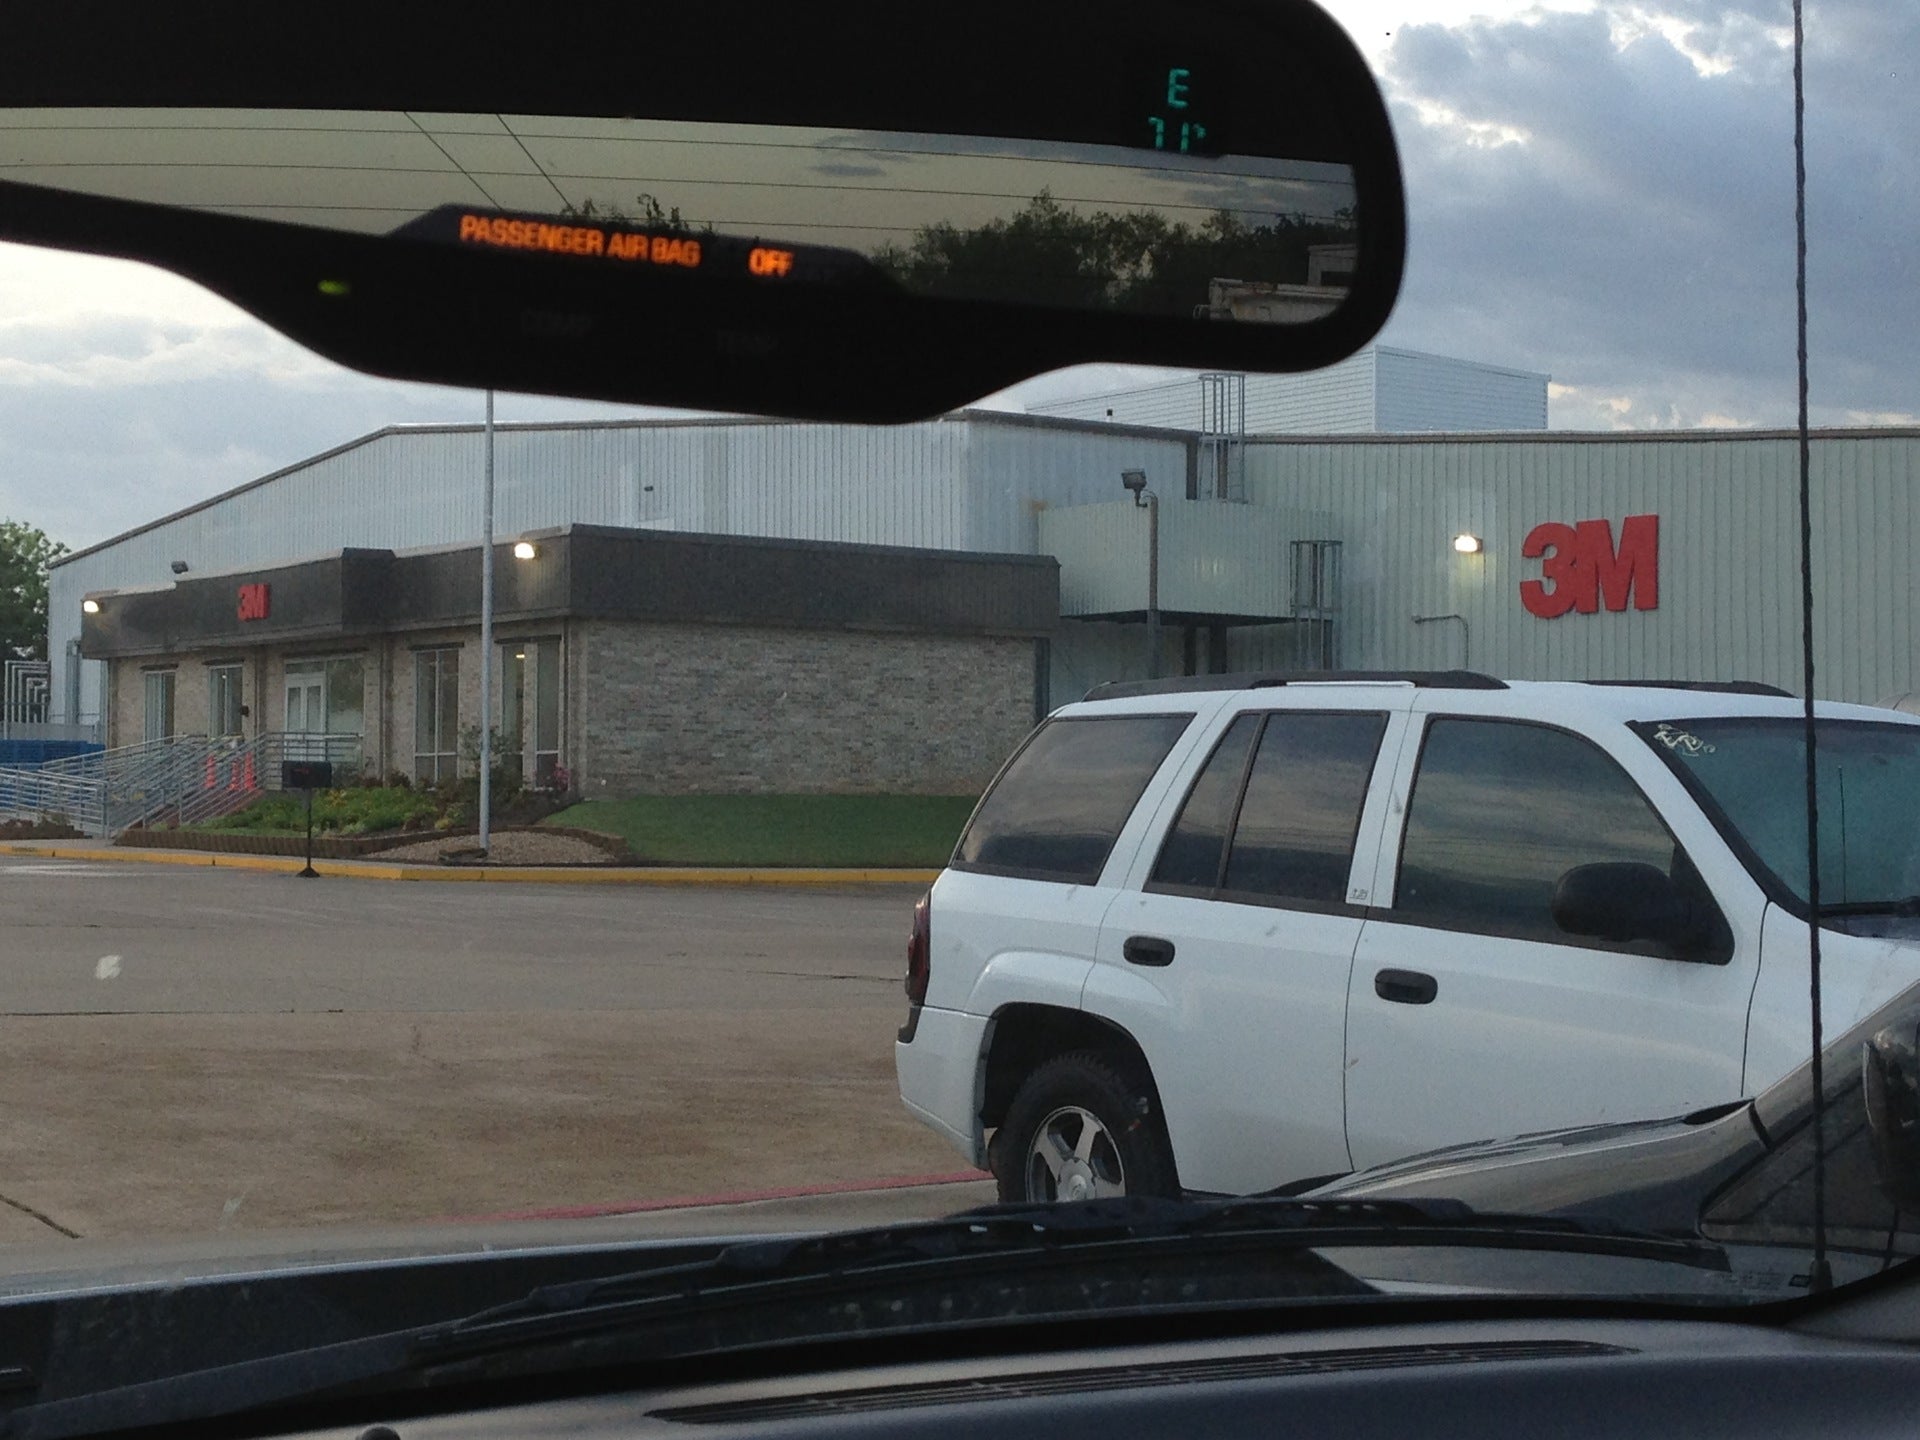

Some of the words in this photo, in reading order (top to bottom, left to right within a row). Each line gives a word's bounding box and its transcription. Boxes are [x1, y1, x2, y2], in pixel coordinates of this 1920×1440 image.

[1167, 68, 1190, 108] E
[460, 214, 603, 256] PASSENGER
[607, 232, 648, 261] AIR
[651, 236, 701, 267] BAG
[749, 247, 794, 277] OFF
[1519, 514, 1659, 619] 3M
[237, 583, 269, 622] 3M
